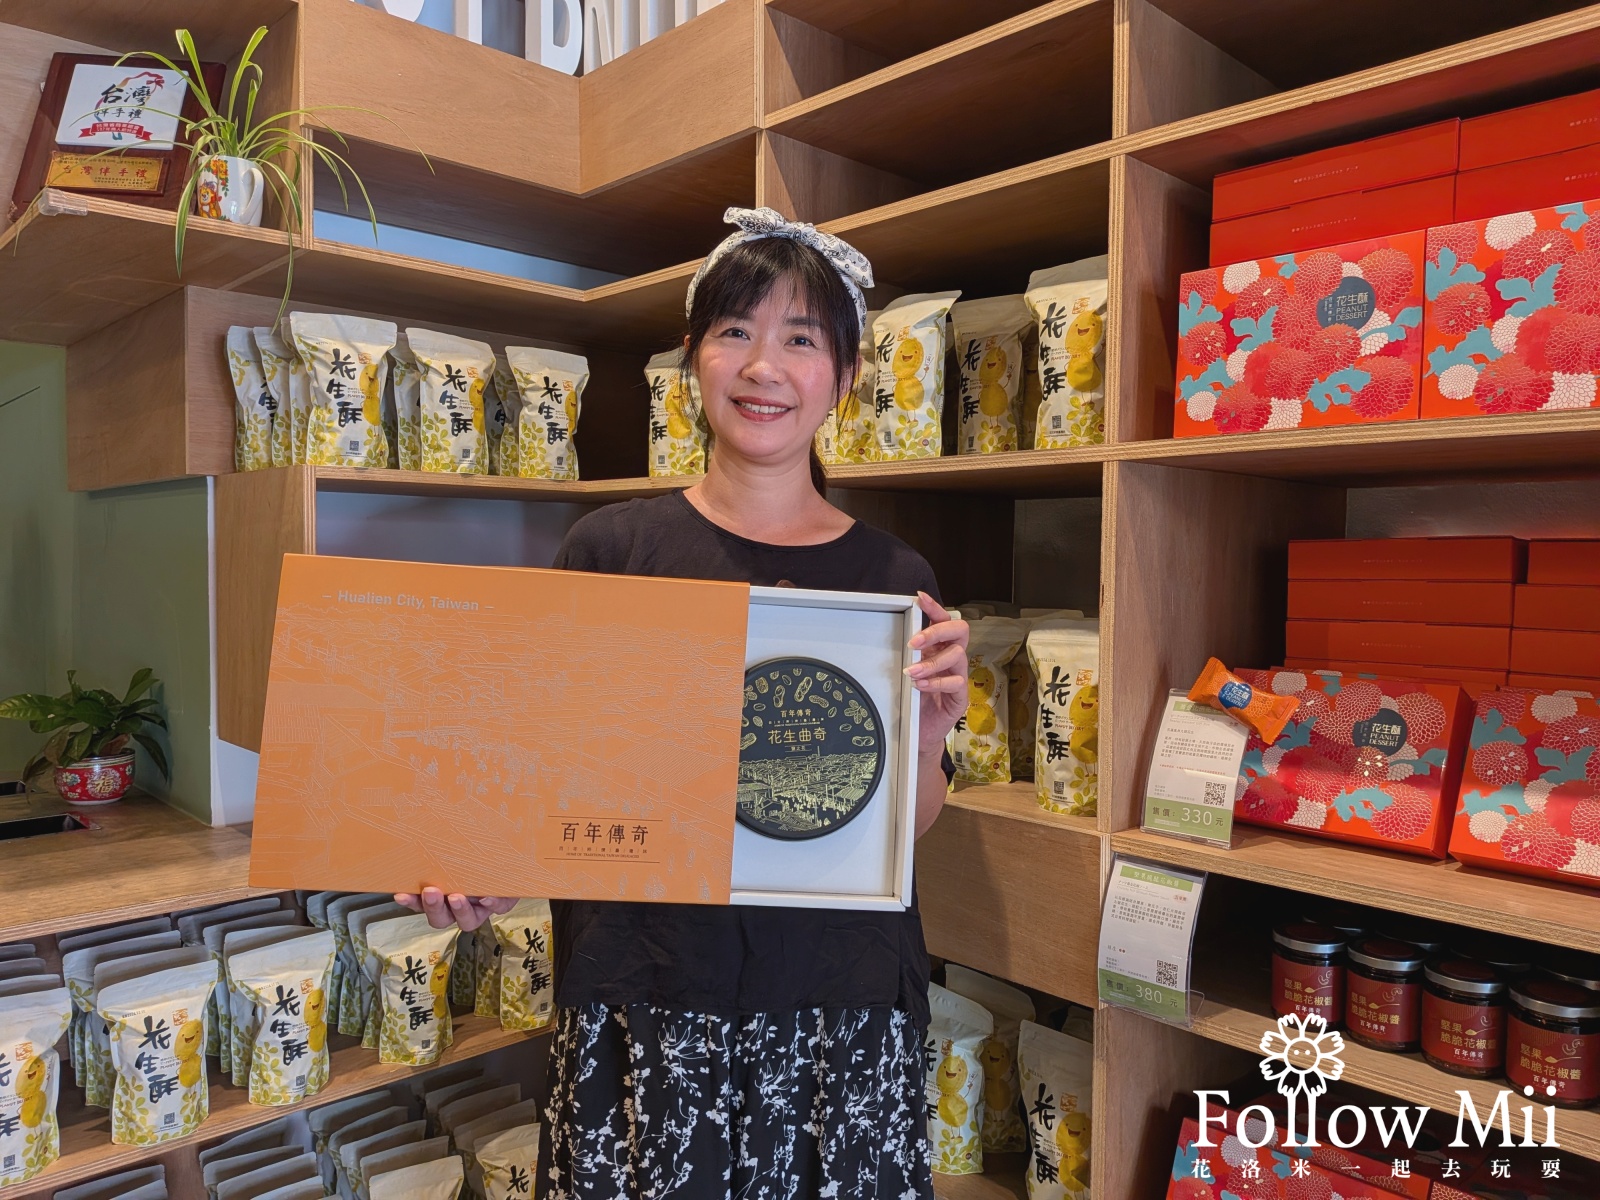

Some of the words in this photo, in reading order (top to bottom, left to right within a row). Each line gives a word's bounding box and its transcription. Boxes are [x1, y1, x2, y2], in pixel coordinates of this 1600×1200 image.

[101, 84, 151, 106] 台灣
[63, 165, 147, 178] 台灣伴手禮
[1336, 292, 1369, 307] 花生酥
[1336, 304, 1368, 314] PEANUT
[1336, 311, 1368, 321] DESSERT
[326, 348, 364, 428] 花生酥
[439, 364, 473, 437] 花生酥
[538, 376, 568, 445] 花生酥
[337, 590, 392, 605] Hualien
[396, 594, 425, 609] City,
[430, 596, 479, 611] Taiwan
[780, 708, 812, 718] 百年傳奇
[768, 727, 827, 745] 花生曲奇
[1370, 732, 1400, 741] PEANUT
[1371, 722, 1402, 735] 花生酥
[1369, 738, 1399, 747] DESSERT
[1181, 807, 1212, 826] 330
[1215, 817, 1224, 827] 元
[561, 821, 649, 846] 百年傳奇
[523, 927, 552, 996] 花生酥
[399, 955, 434, 1031] 花生酥
[1135, 984, 1162, 1004] 380
[1170, 998, 1178, 1008] 元
[269, 985, 309, 1066] 花生酥
[135, 1015, 180, 1104] 花生酥
[160, 1062, 176, 1070] PEANUT
